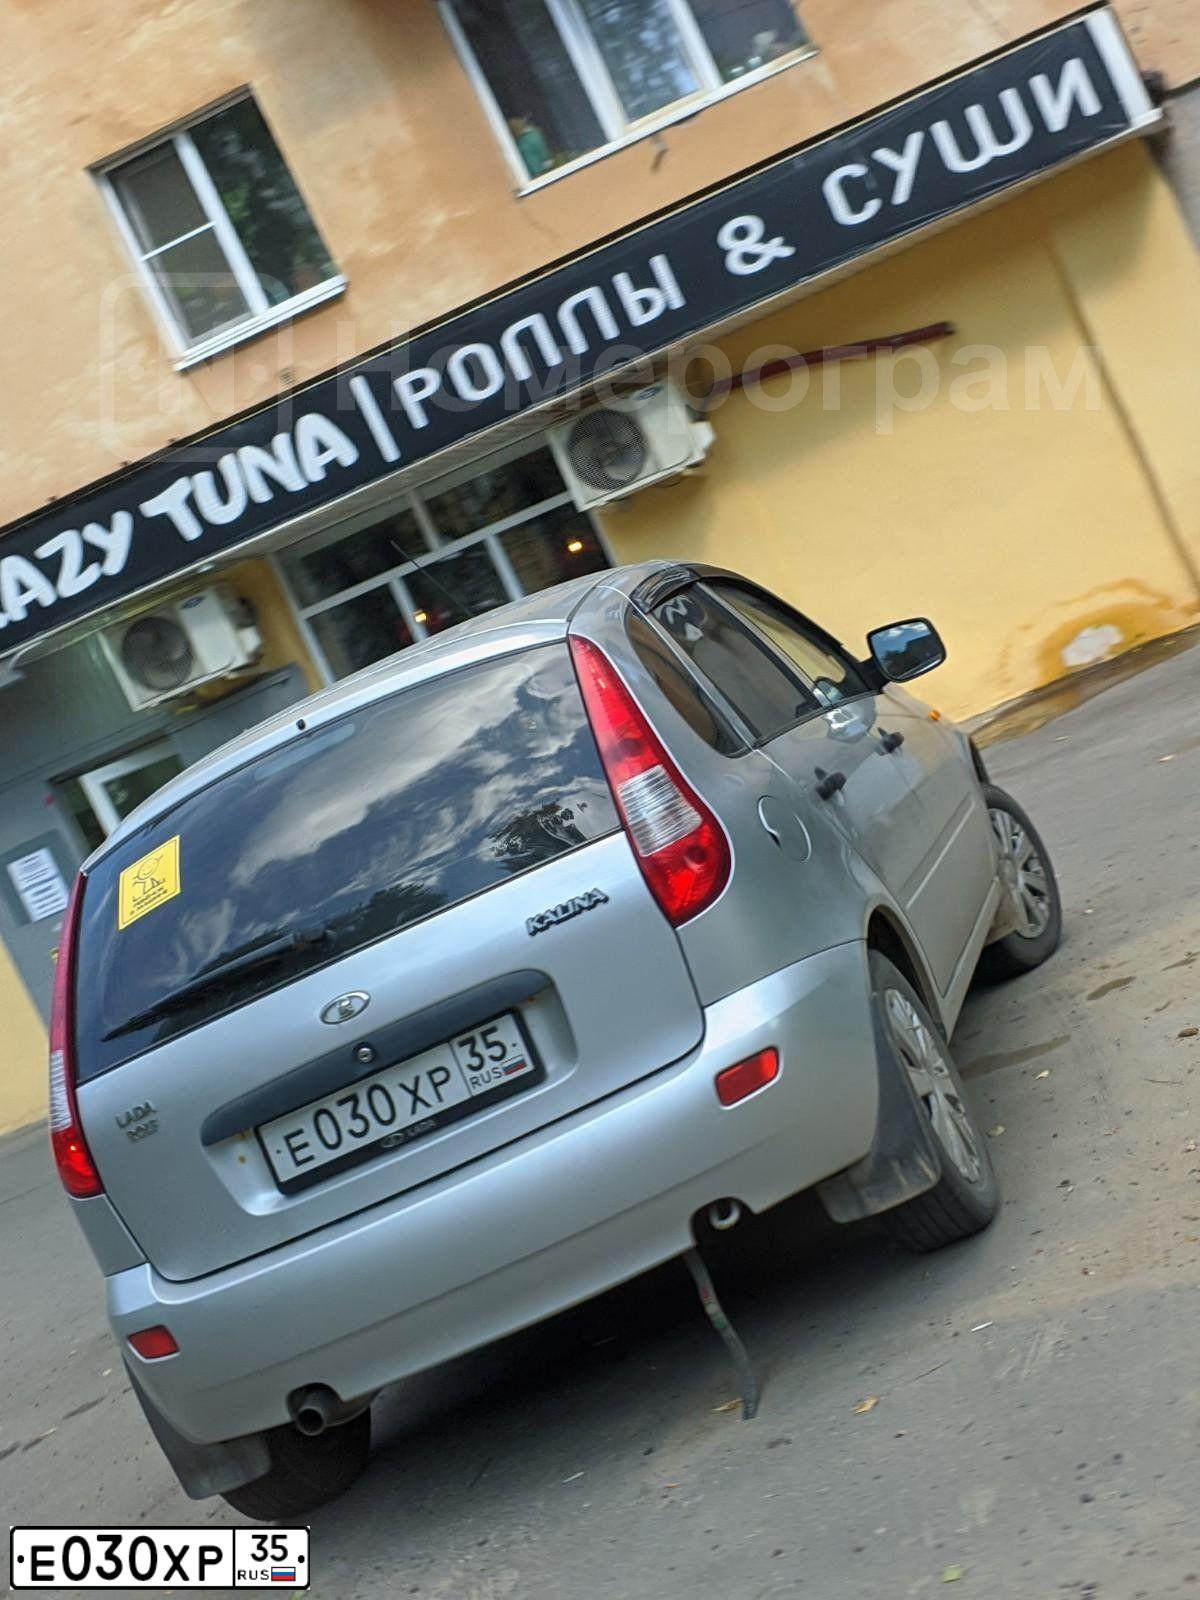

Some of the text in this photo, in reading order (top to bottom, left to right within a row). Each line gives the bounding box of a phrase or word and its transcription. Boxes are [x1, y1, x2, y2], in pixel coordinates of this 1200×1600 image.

[393, 57, 1103, 430] РОЛЛЫ & СУШИ
[0, 412, 361, 629] AZY TUNA
[525, 887, 609, 937] KALINA
[458, 1026, 508, 1072] 35
[469, 1066, 503, 1089] RUS
